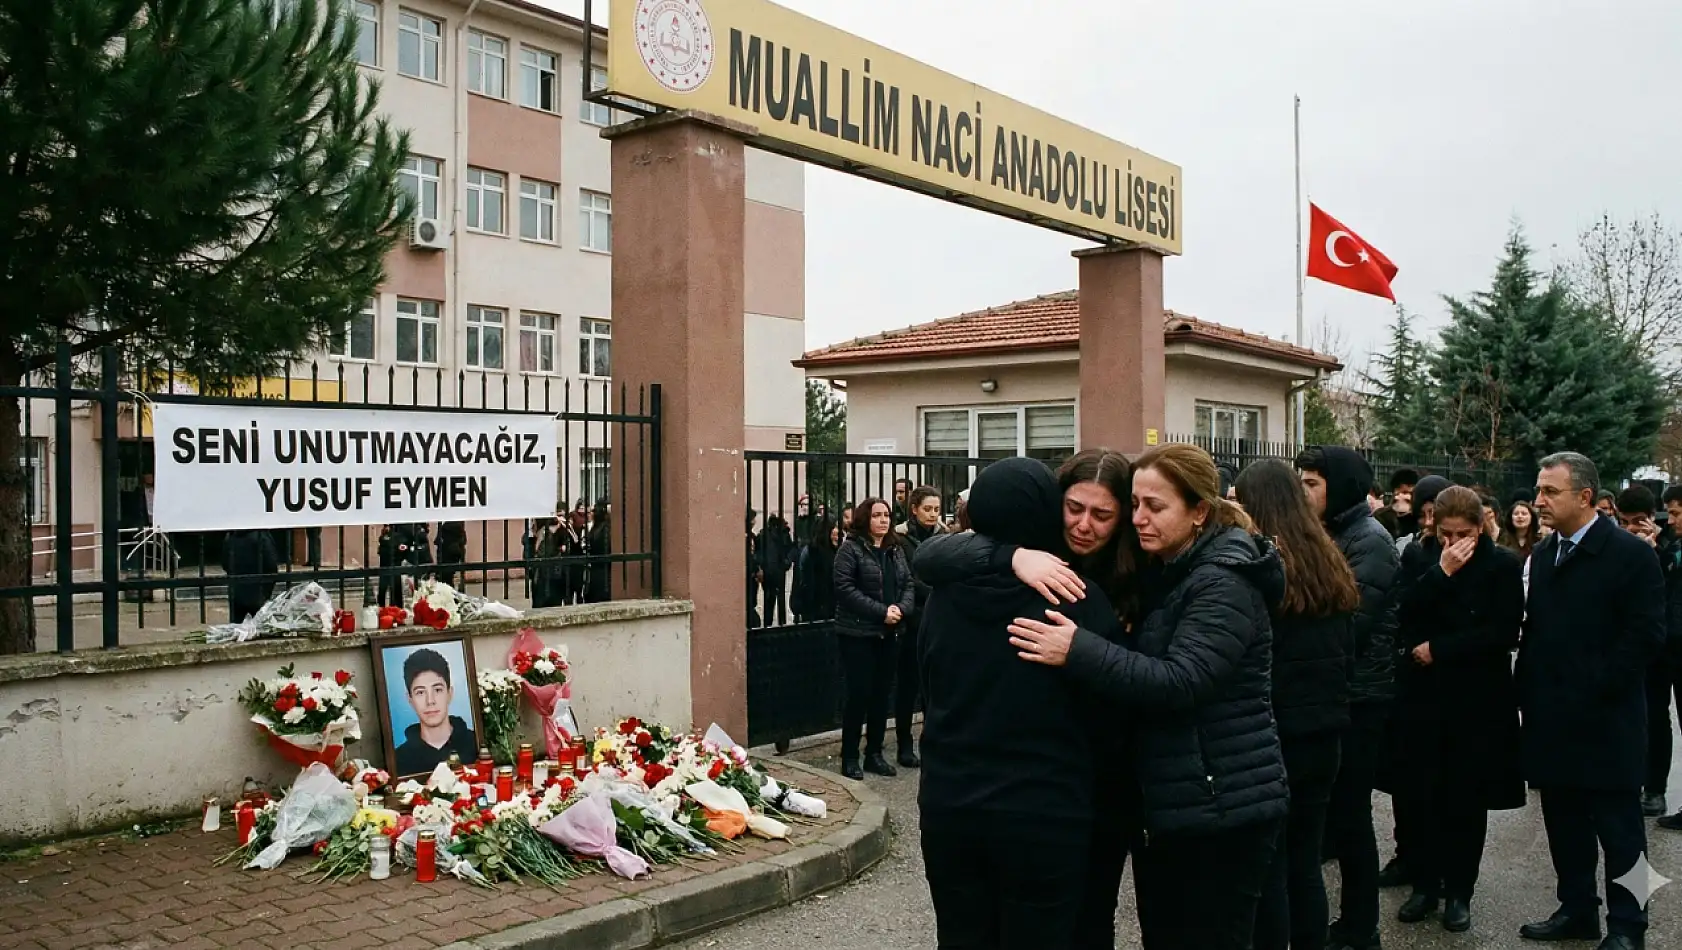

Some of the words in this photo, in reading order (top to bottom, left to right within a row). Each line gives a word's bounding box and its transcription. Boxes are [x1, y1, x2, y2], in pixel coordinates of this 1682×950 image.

[729, 27, 899, 156] MUALLİM
[911, 94, 982, 182] NACİ
[990, 126, 1108, 220] ANADOLU
[1114, 159, 1176, 241] LİSESİ
[172, 420, 260, 464] SENİ
[273, 425, 546, 471] UNUTMAYACAĞIZ,
[256, 477, 373, 513] YUSUF
[384, 475, 488, 509] EYMEN
